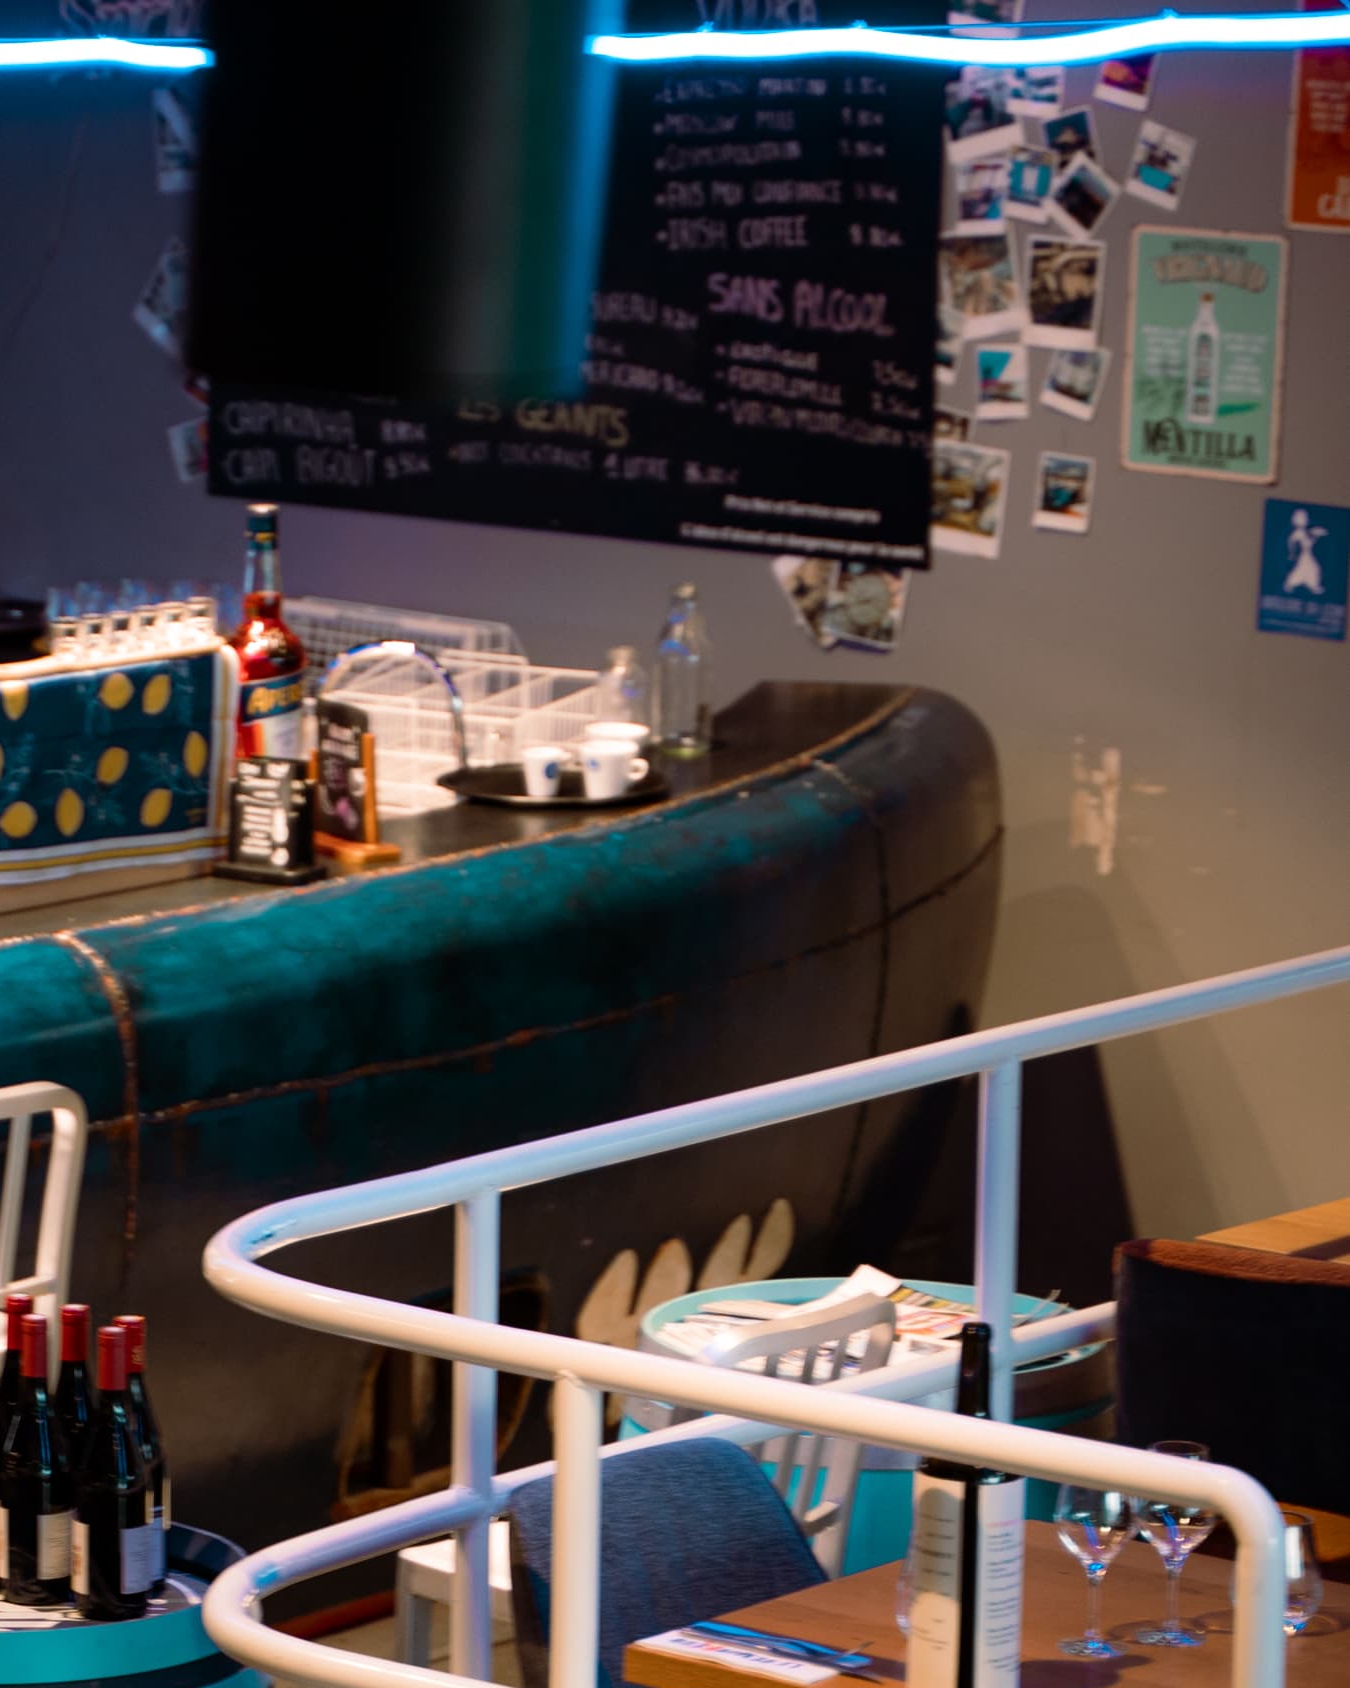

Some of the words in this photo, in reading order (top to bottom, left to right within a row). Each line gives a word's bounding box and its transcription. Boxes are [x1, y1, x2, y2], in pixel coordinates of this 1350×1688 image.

[736, 212, 810, 250] COFFEE
[705, 271, 784, 324] SANS
[792, 277, 896, 337] ALCOOL
